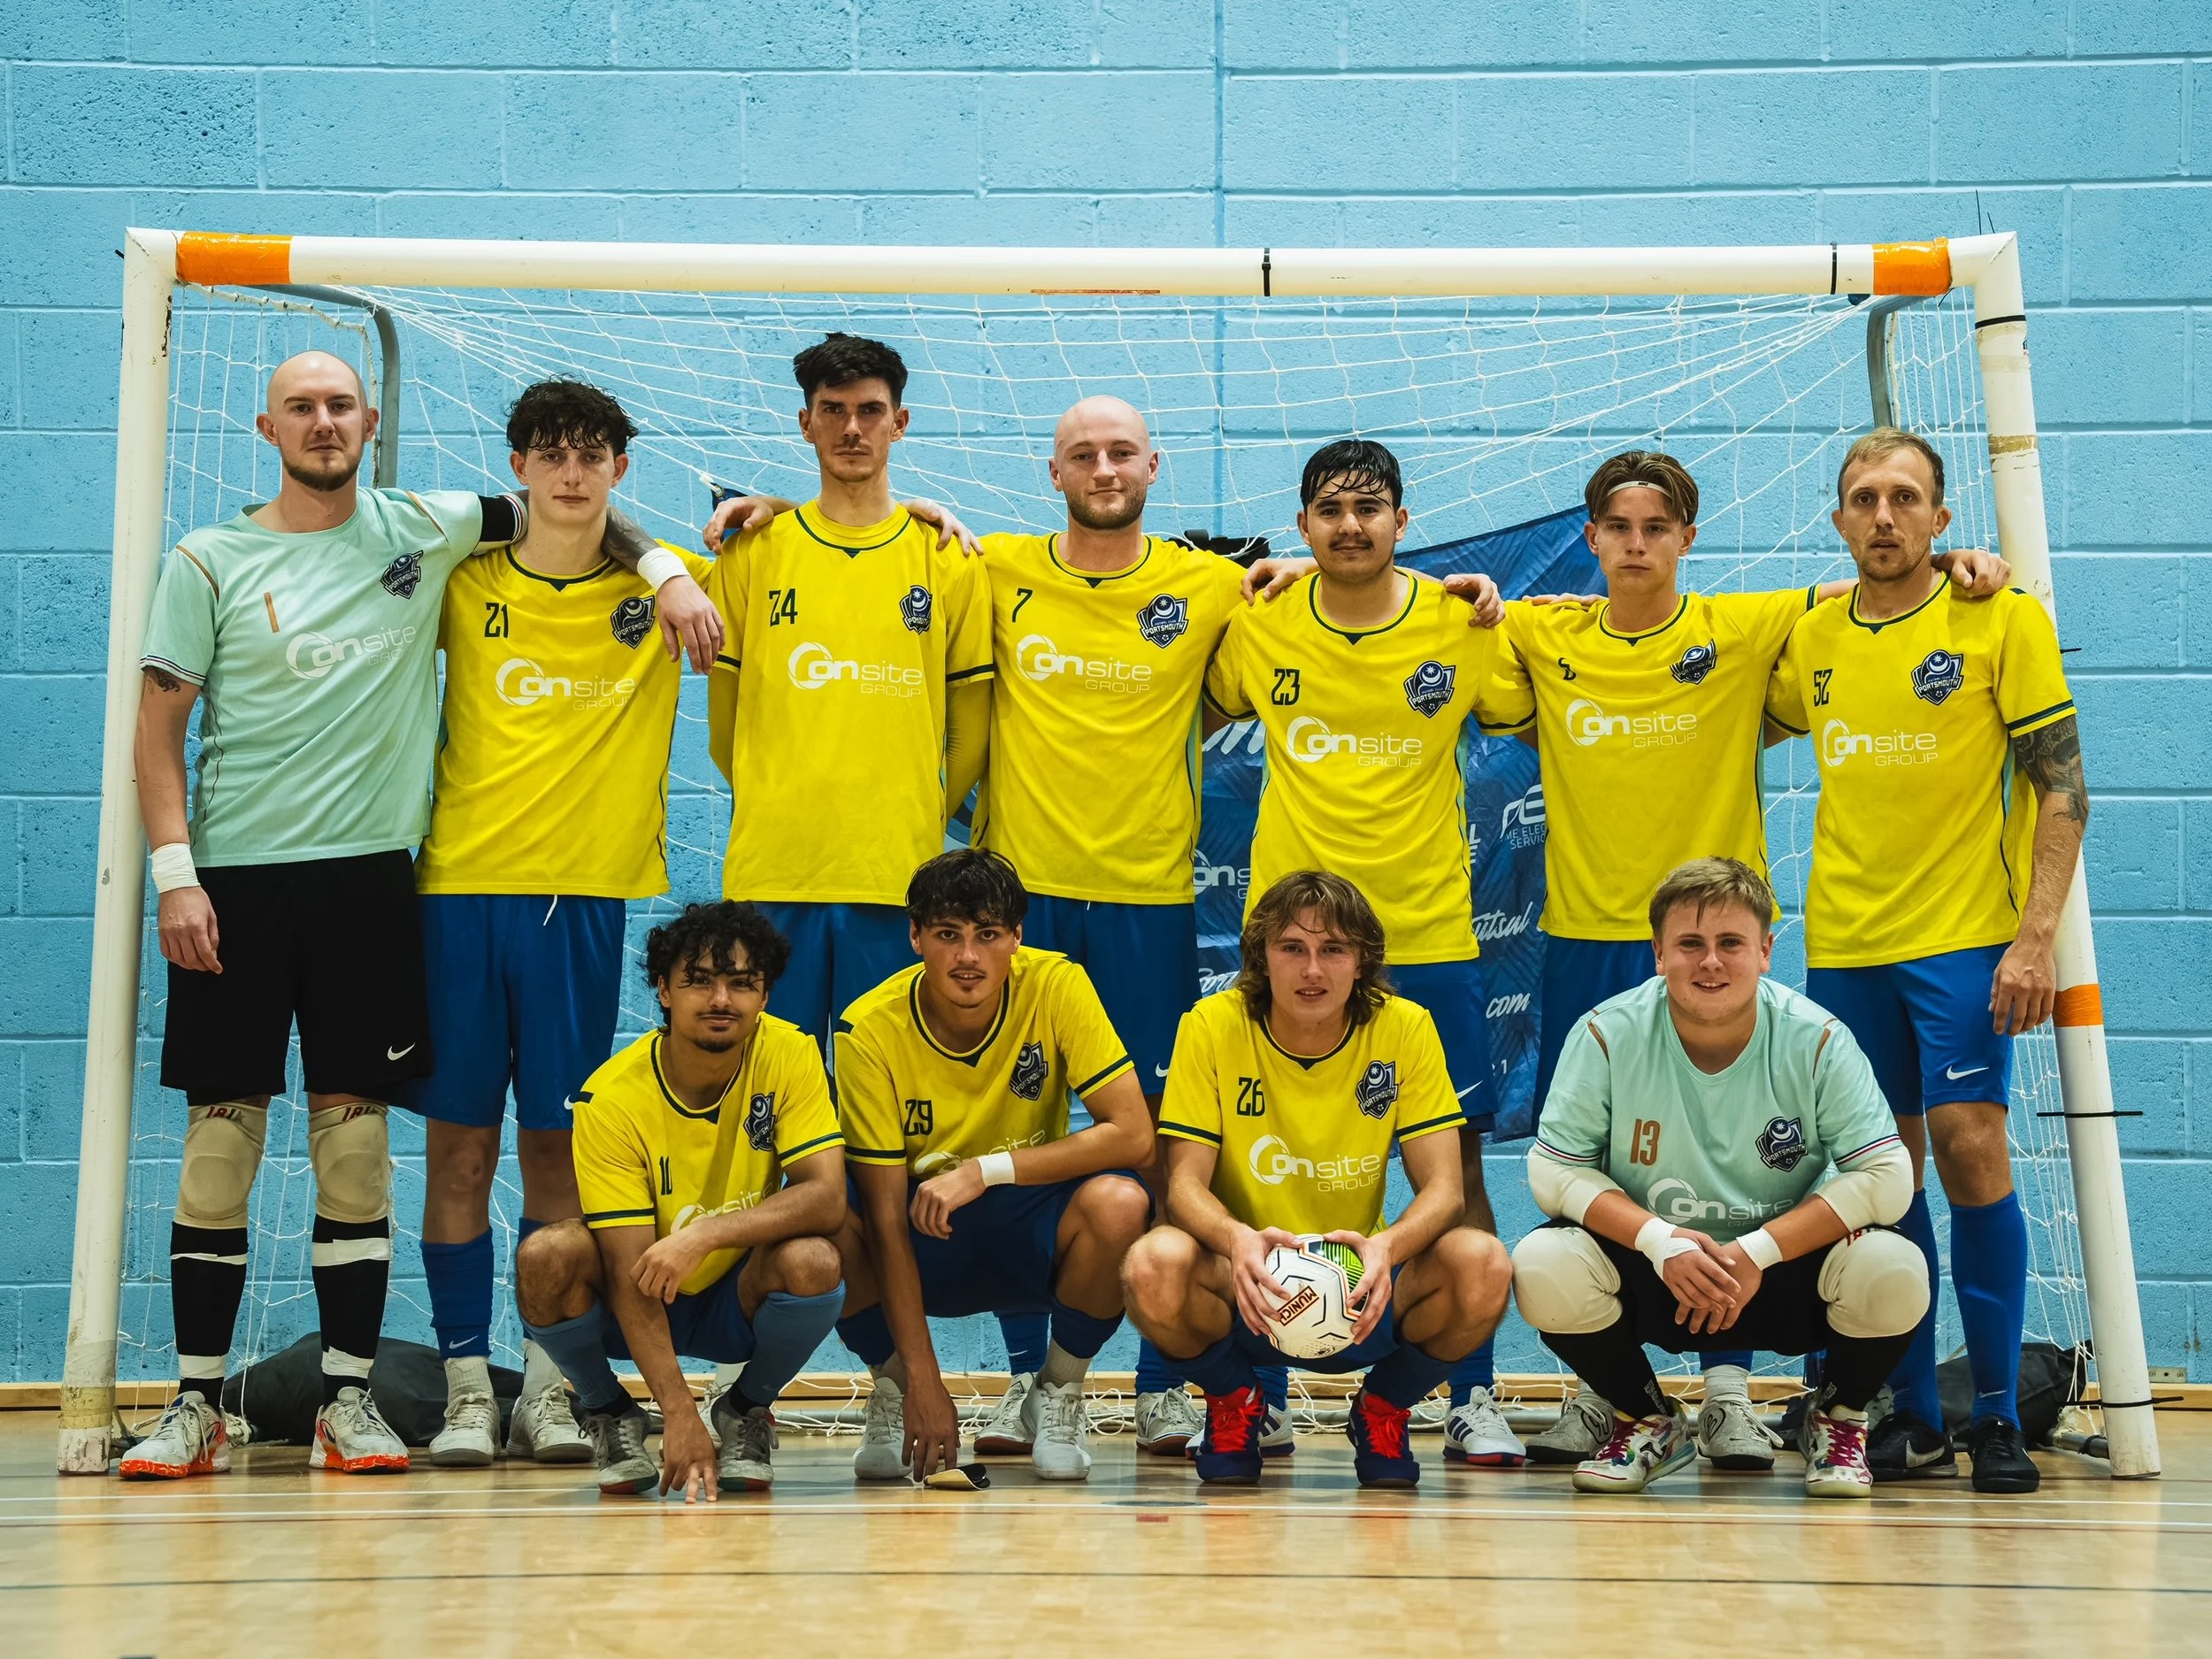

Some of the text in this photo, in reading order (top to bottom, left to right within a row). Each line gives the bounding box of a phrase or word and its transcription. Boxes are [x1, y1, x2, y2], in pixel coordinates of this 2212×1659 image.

[768, 588, 798, 627] 24
[1011, 588, 1033, 623] 7
[484, 602, 509, 638] 21
[617, 621, 651, 637] PORTSMOUTH
[1145, 622, 1184, 636] PORTSMOUTH
[860, 683, 921, 698] GROUP
[1085, 679, 1150, 694] GROUP
[1271, 668, 1300, 705] 23
[1813, 668, 1833, 707] 52
[1917, 679, 1958, 694] PORTSMOUTH
[1412, 690, 1449, 705] PORTSMOUTH
[1633, 732, 1697, 748] GROUP
[1357, 754, 1421, 769] GROUP
[1875, 752, 1939, 767] GROUP
[1510, 833, 1546, 850] SERVIC
[1237, 1077, 1265, 1117] 26
[1362, 1087, 1394, 1110] PORTSMOUTH
[903, 1099, 934, 1137] 29
[751, 1125, 770, 1144] PORTSM
[1629, 1118, 1661, 1166] 13
[1766, 1145, 1806, 1163] PORTSMOUTH
[1317, 1172, 1381, 1192] GROUP
